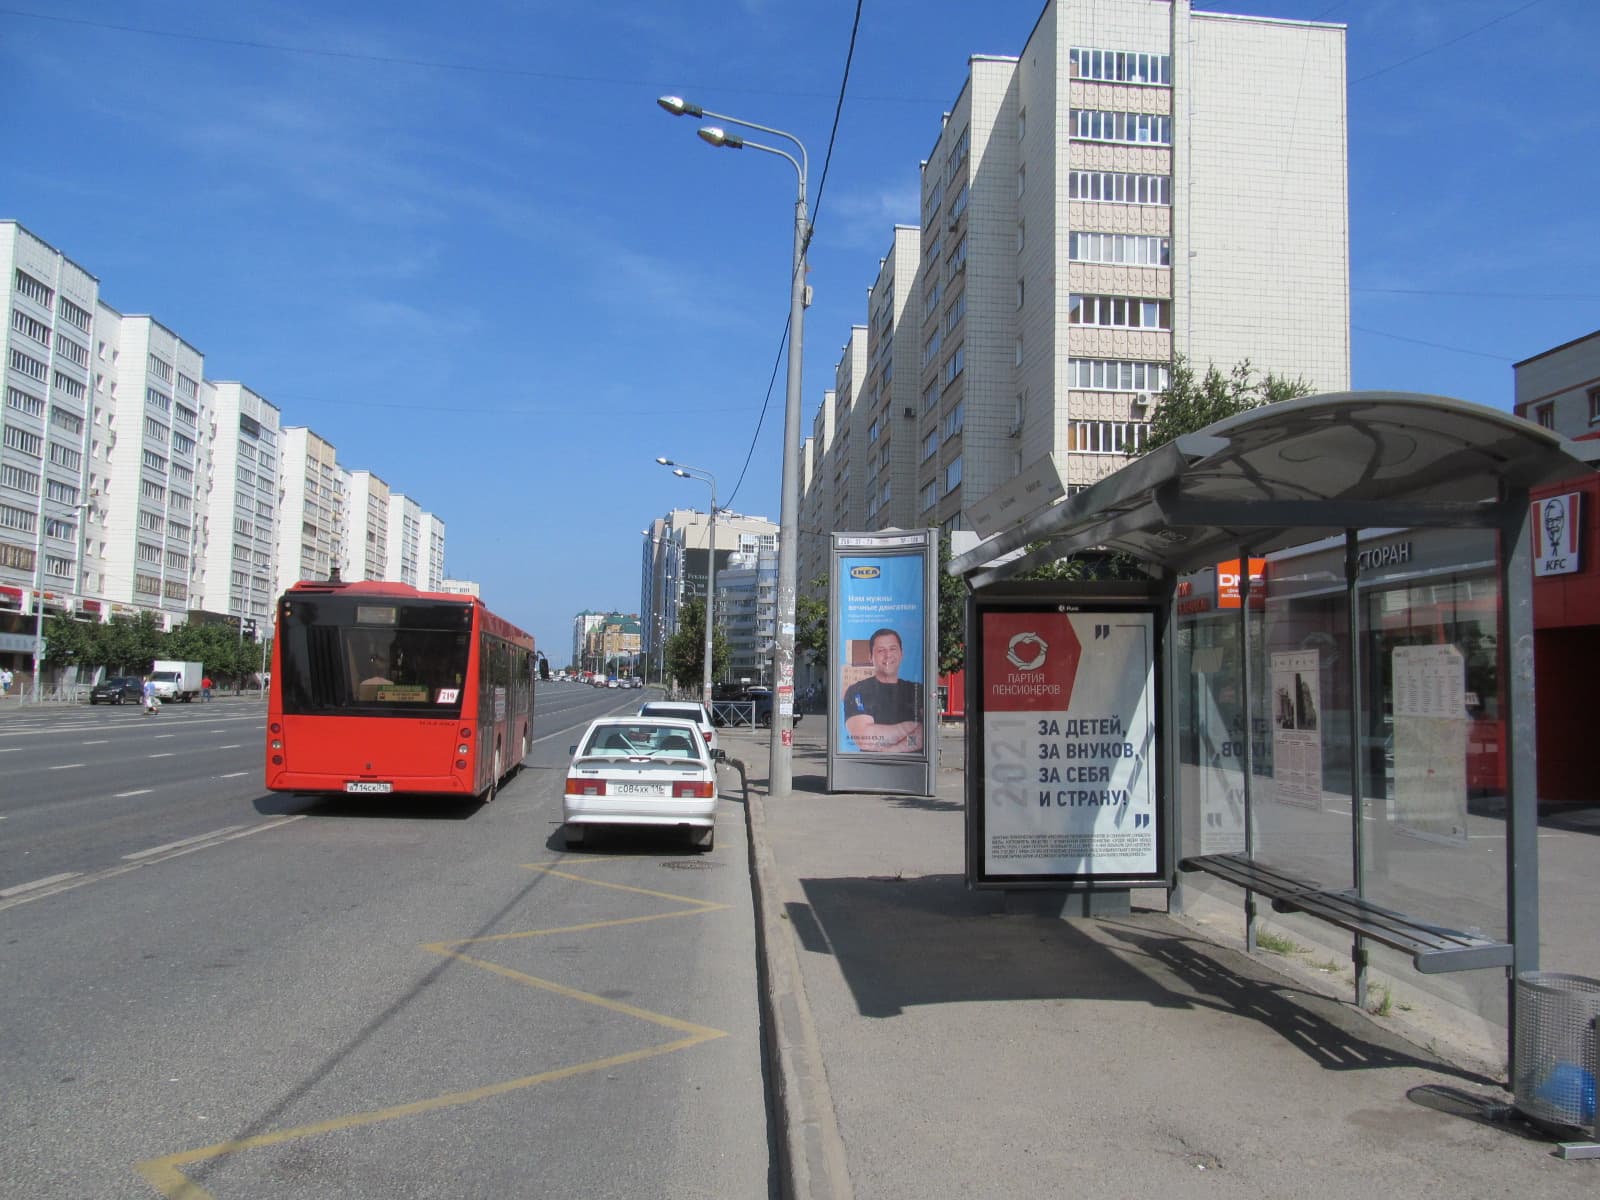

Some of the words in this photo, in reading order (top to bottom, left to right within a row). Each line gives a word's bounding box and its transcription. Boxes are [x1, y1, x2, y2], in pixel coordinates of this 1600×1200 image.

[1545, 559, 1567, 571] KFC
[1008, 673, 1045, 682] ПАРТИЯ
[442, 692, 455, 701] 719
[992, 684, 1061, 695] ПЕНСИОНЕРОВ
[1038, 719, 1060, 736] ЗА
[1065, 715, 1127, 739] ДЕТЕЙ,
[1038, 743, 1060, 759] ЗА
[1066, 742, 1140, 761] ВНУКОВ,
[1039, 767, 1061, 783] ЗА
[1066, 766, 1110, 783] СЕБЯ
[1039, 790, 1051, 807] И
[1056, 789, 1128, 807] СТРАНУ!
